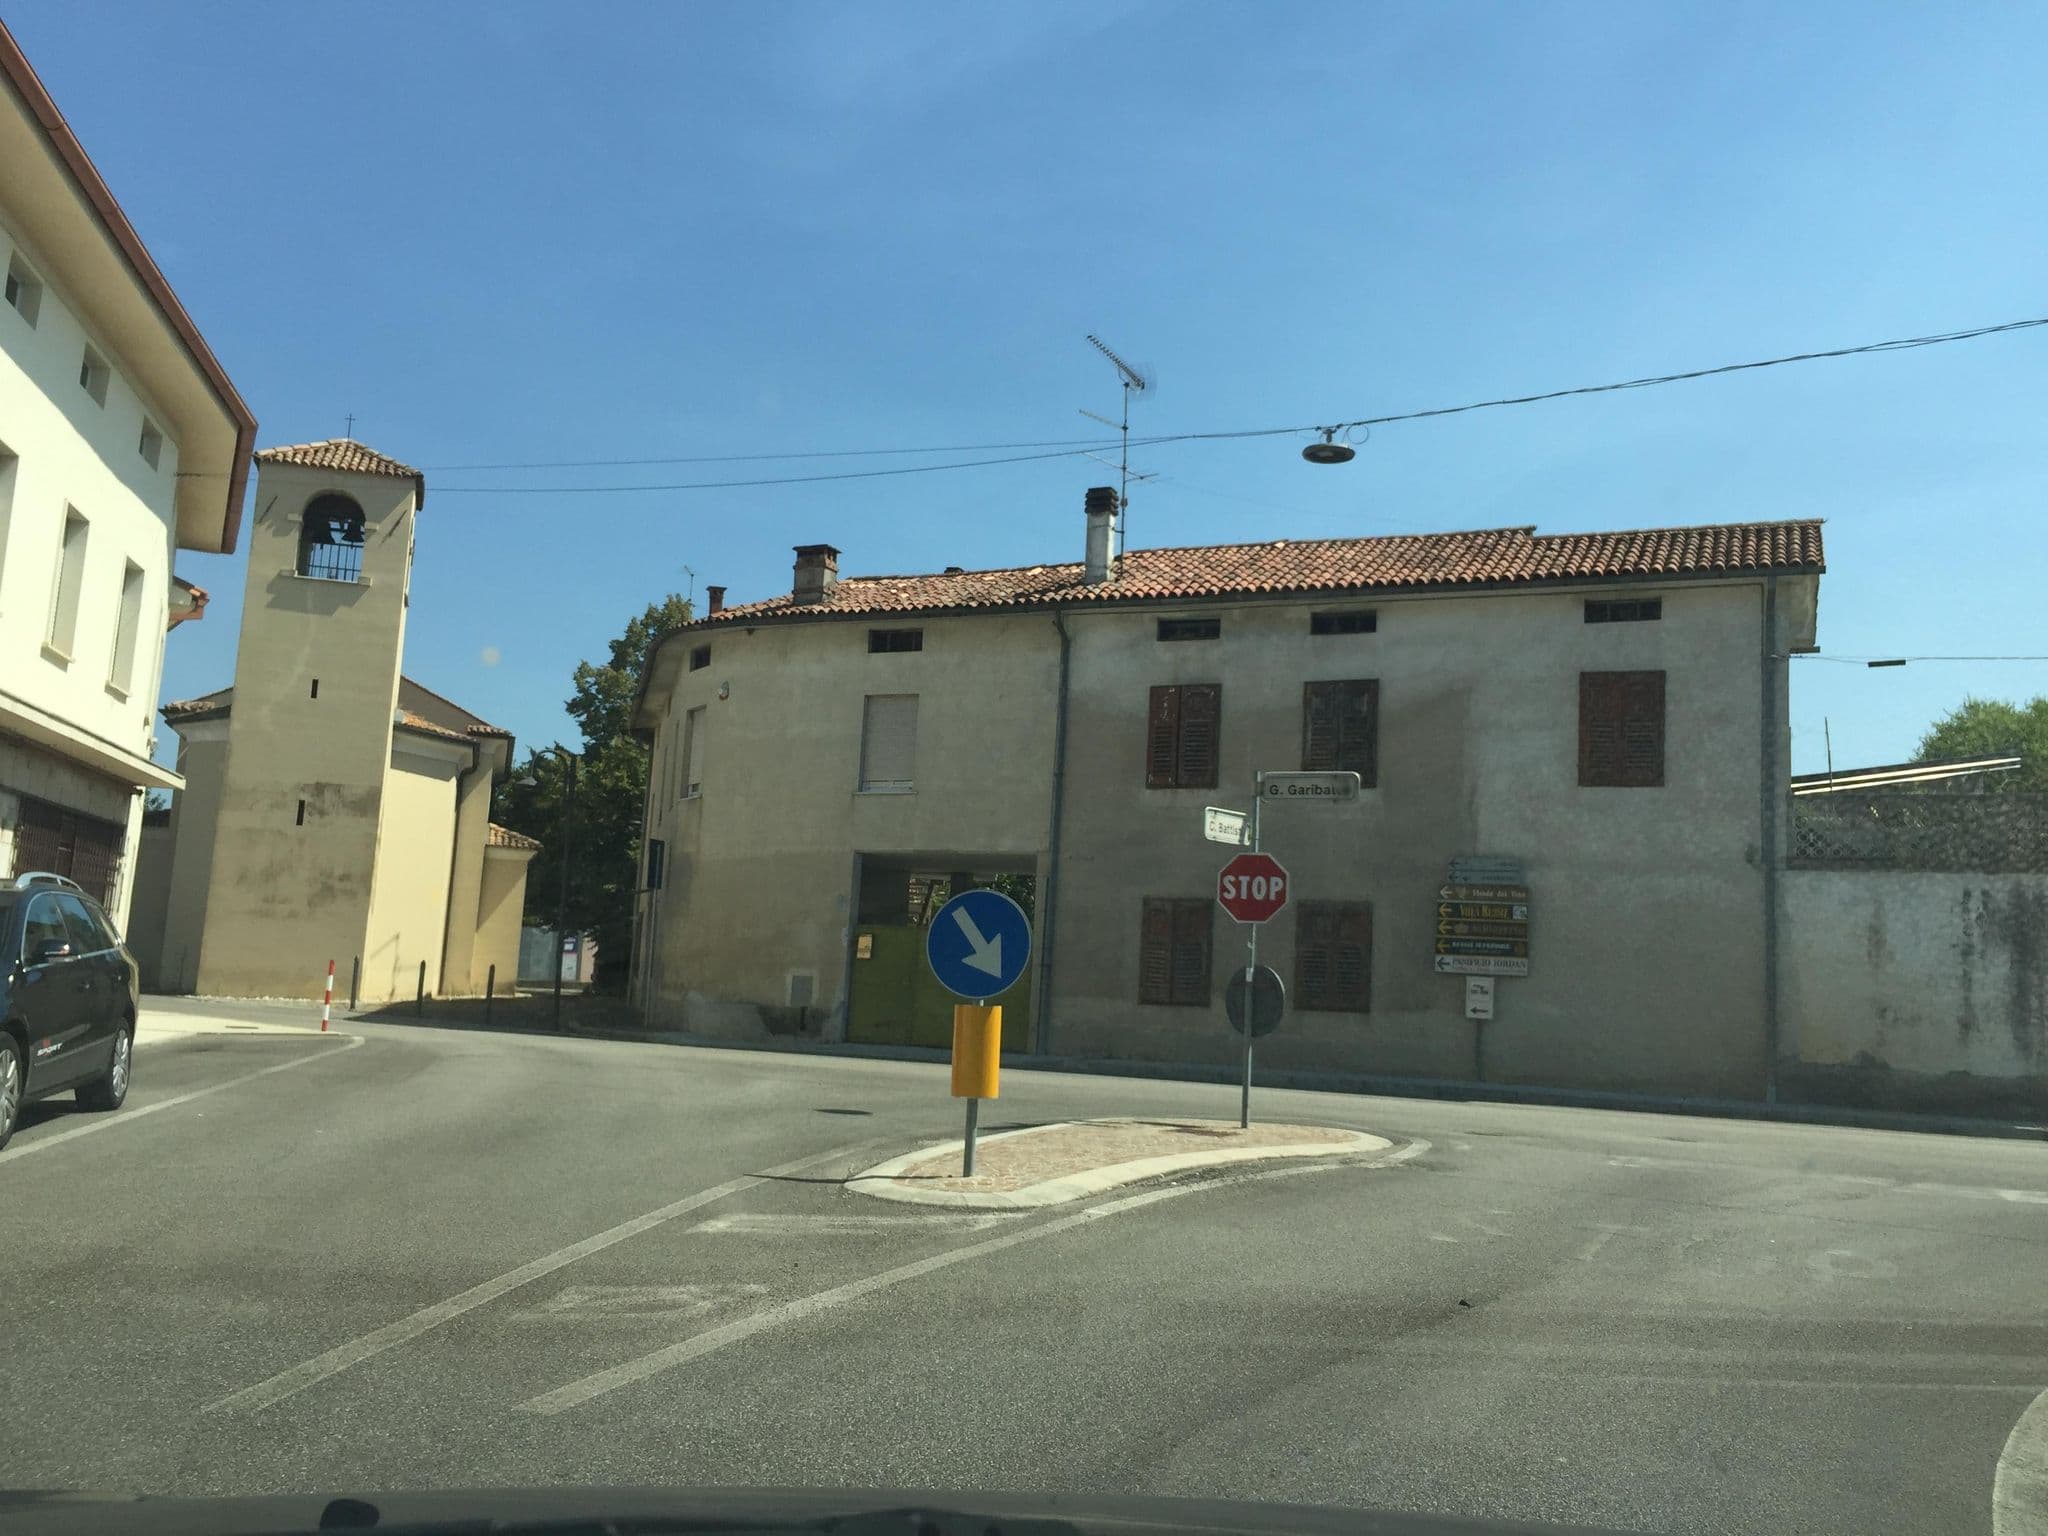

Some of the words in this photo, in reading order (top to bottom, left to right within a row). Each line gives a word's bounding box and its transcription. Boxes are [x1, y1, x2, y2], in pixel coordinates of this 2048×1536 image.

[1269, 784, 1284, 796] G.
[1287, 784, 1343, 796] Garibal
[1223, 875, 1284, 900] STOP
[37, 1042, 63, 1056] SPORT
